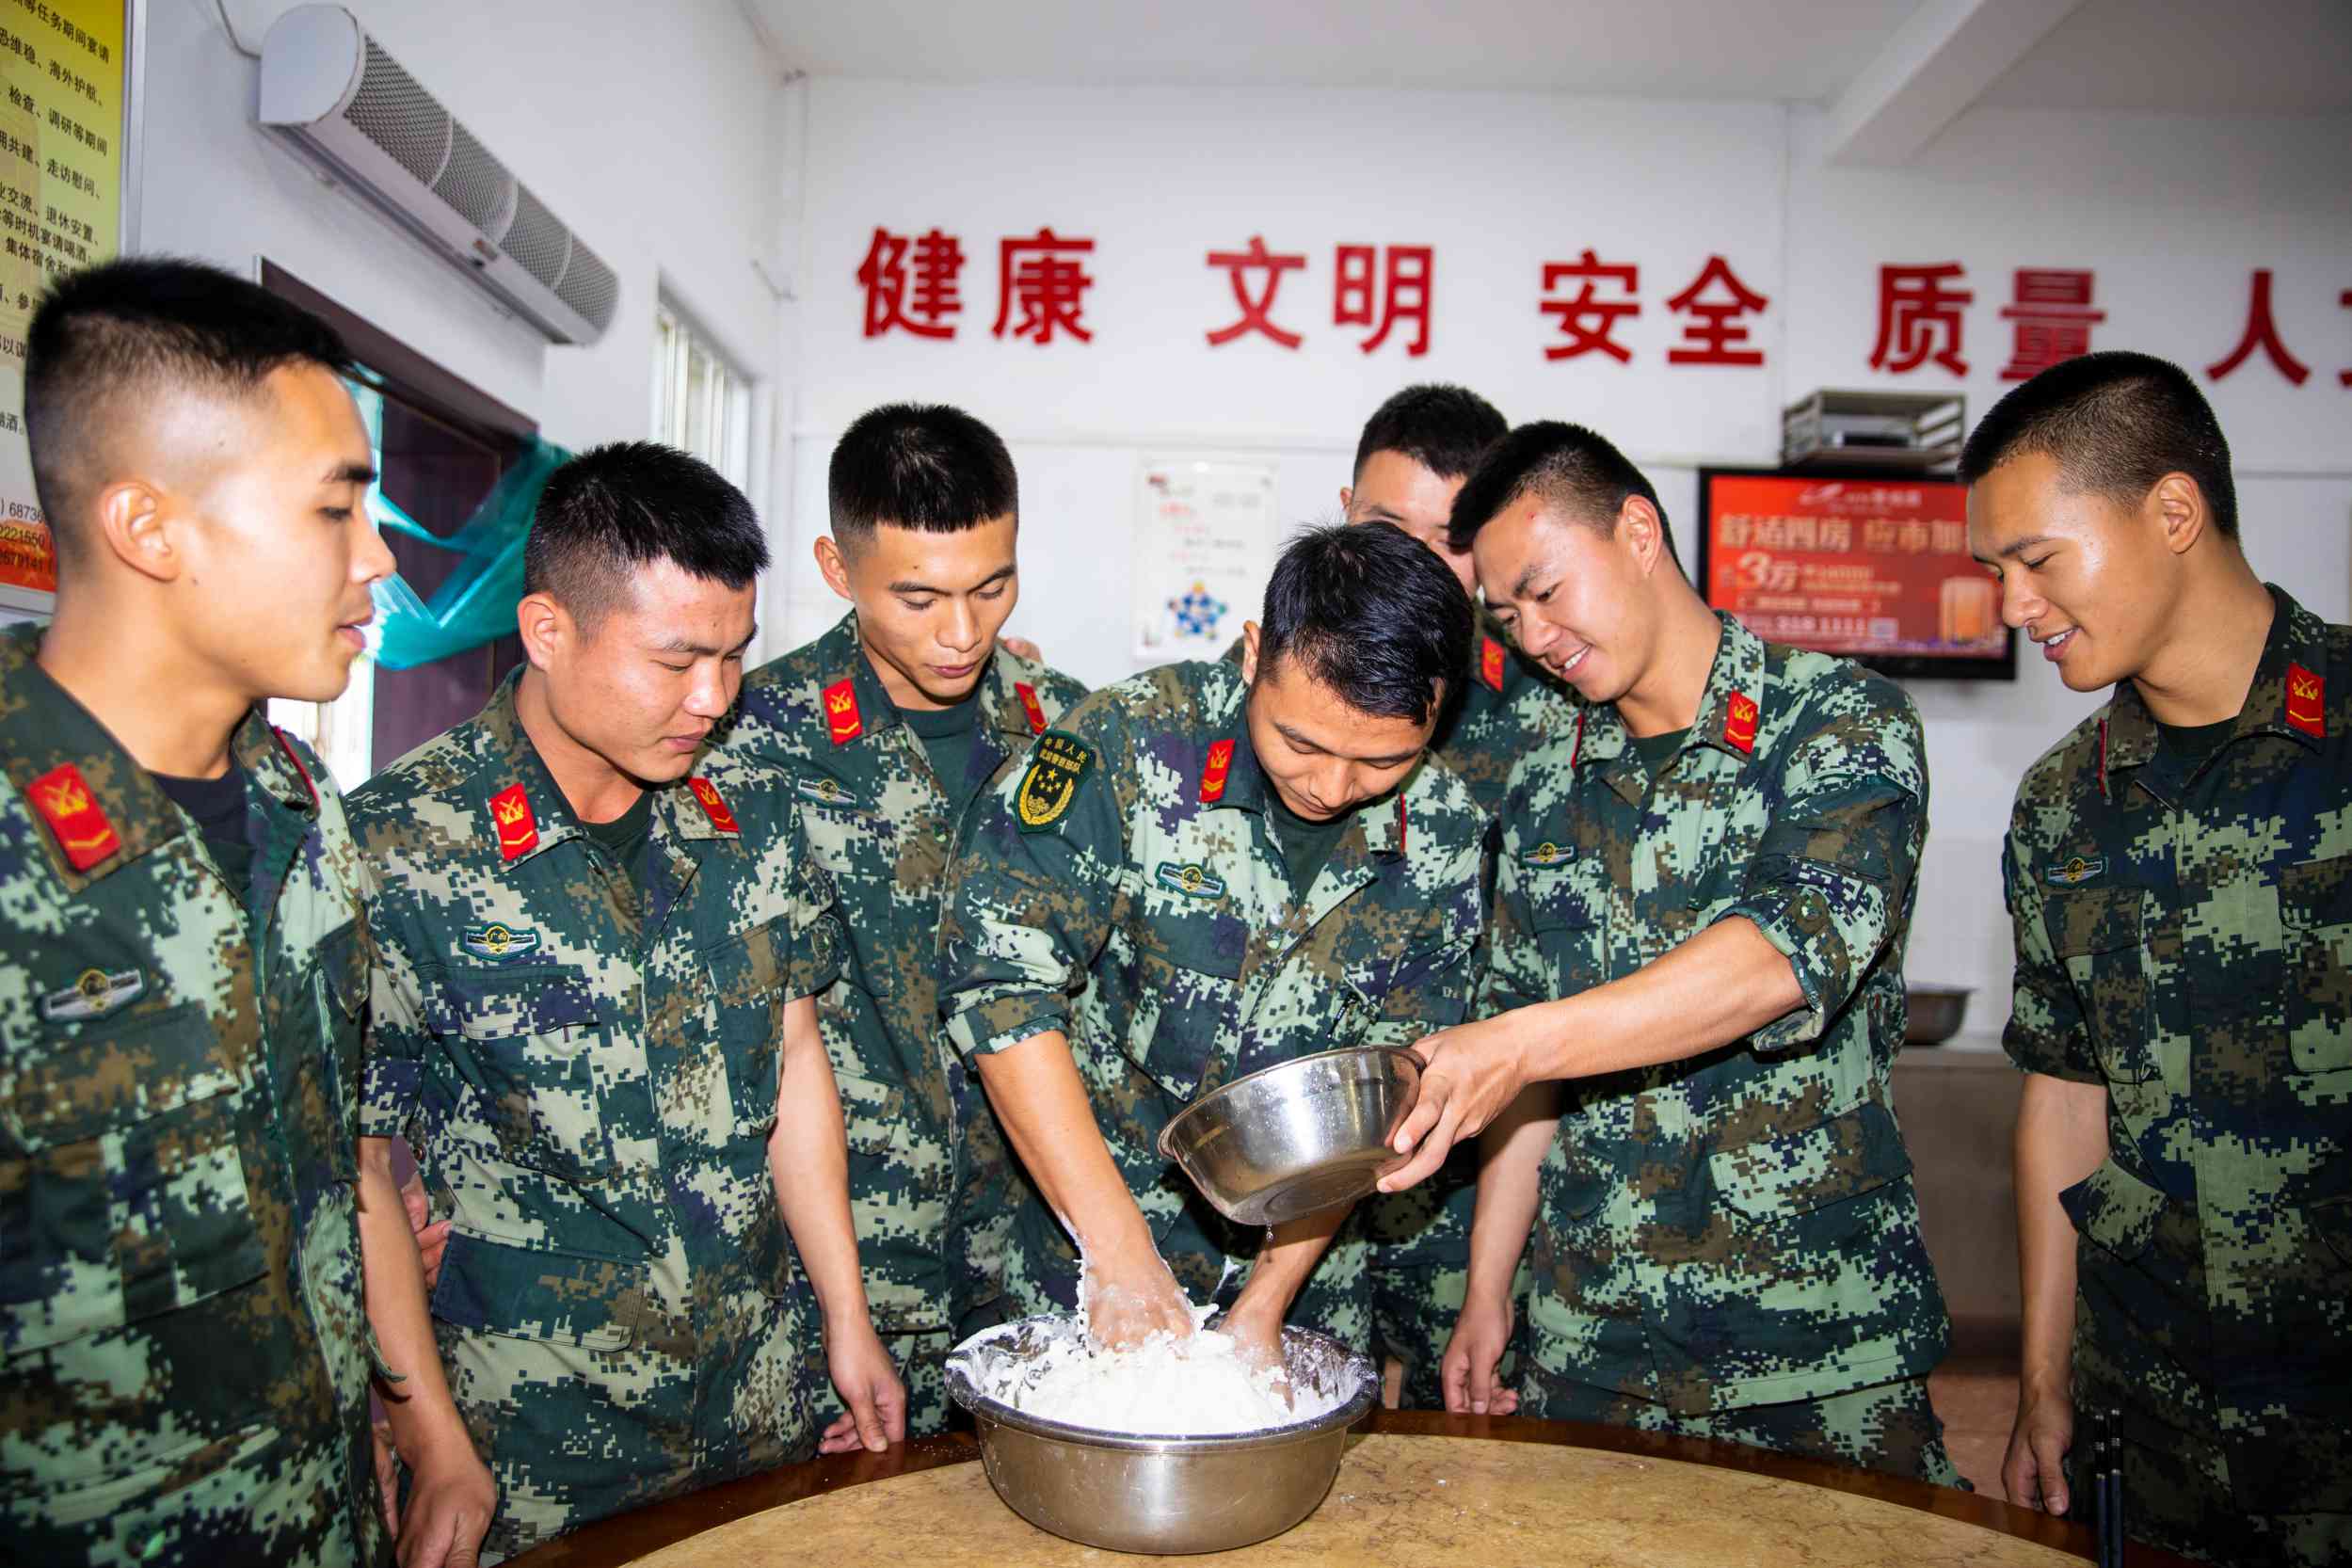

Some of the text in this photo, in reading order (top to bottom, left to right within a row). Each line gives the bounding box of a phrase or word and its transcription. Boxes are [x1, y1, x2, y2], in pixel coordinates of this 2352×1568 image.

[857, 227, 1096, 345] 健康
[1206, 236, 1434, 358] 文明
[1539, 249, 1768, 366] 安全
[1869, 264, 2105, 376] 质量
[1045, 737, 1088, 763] 中国人民
